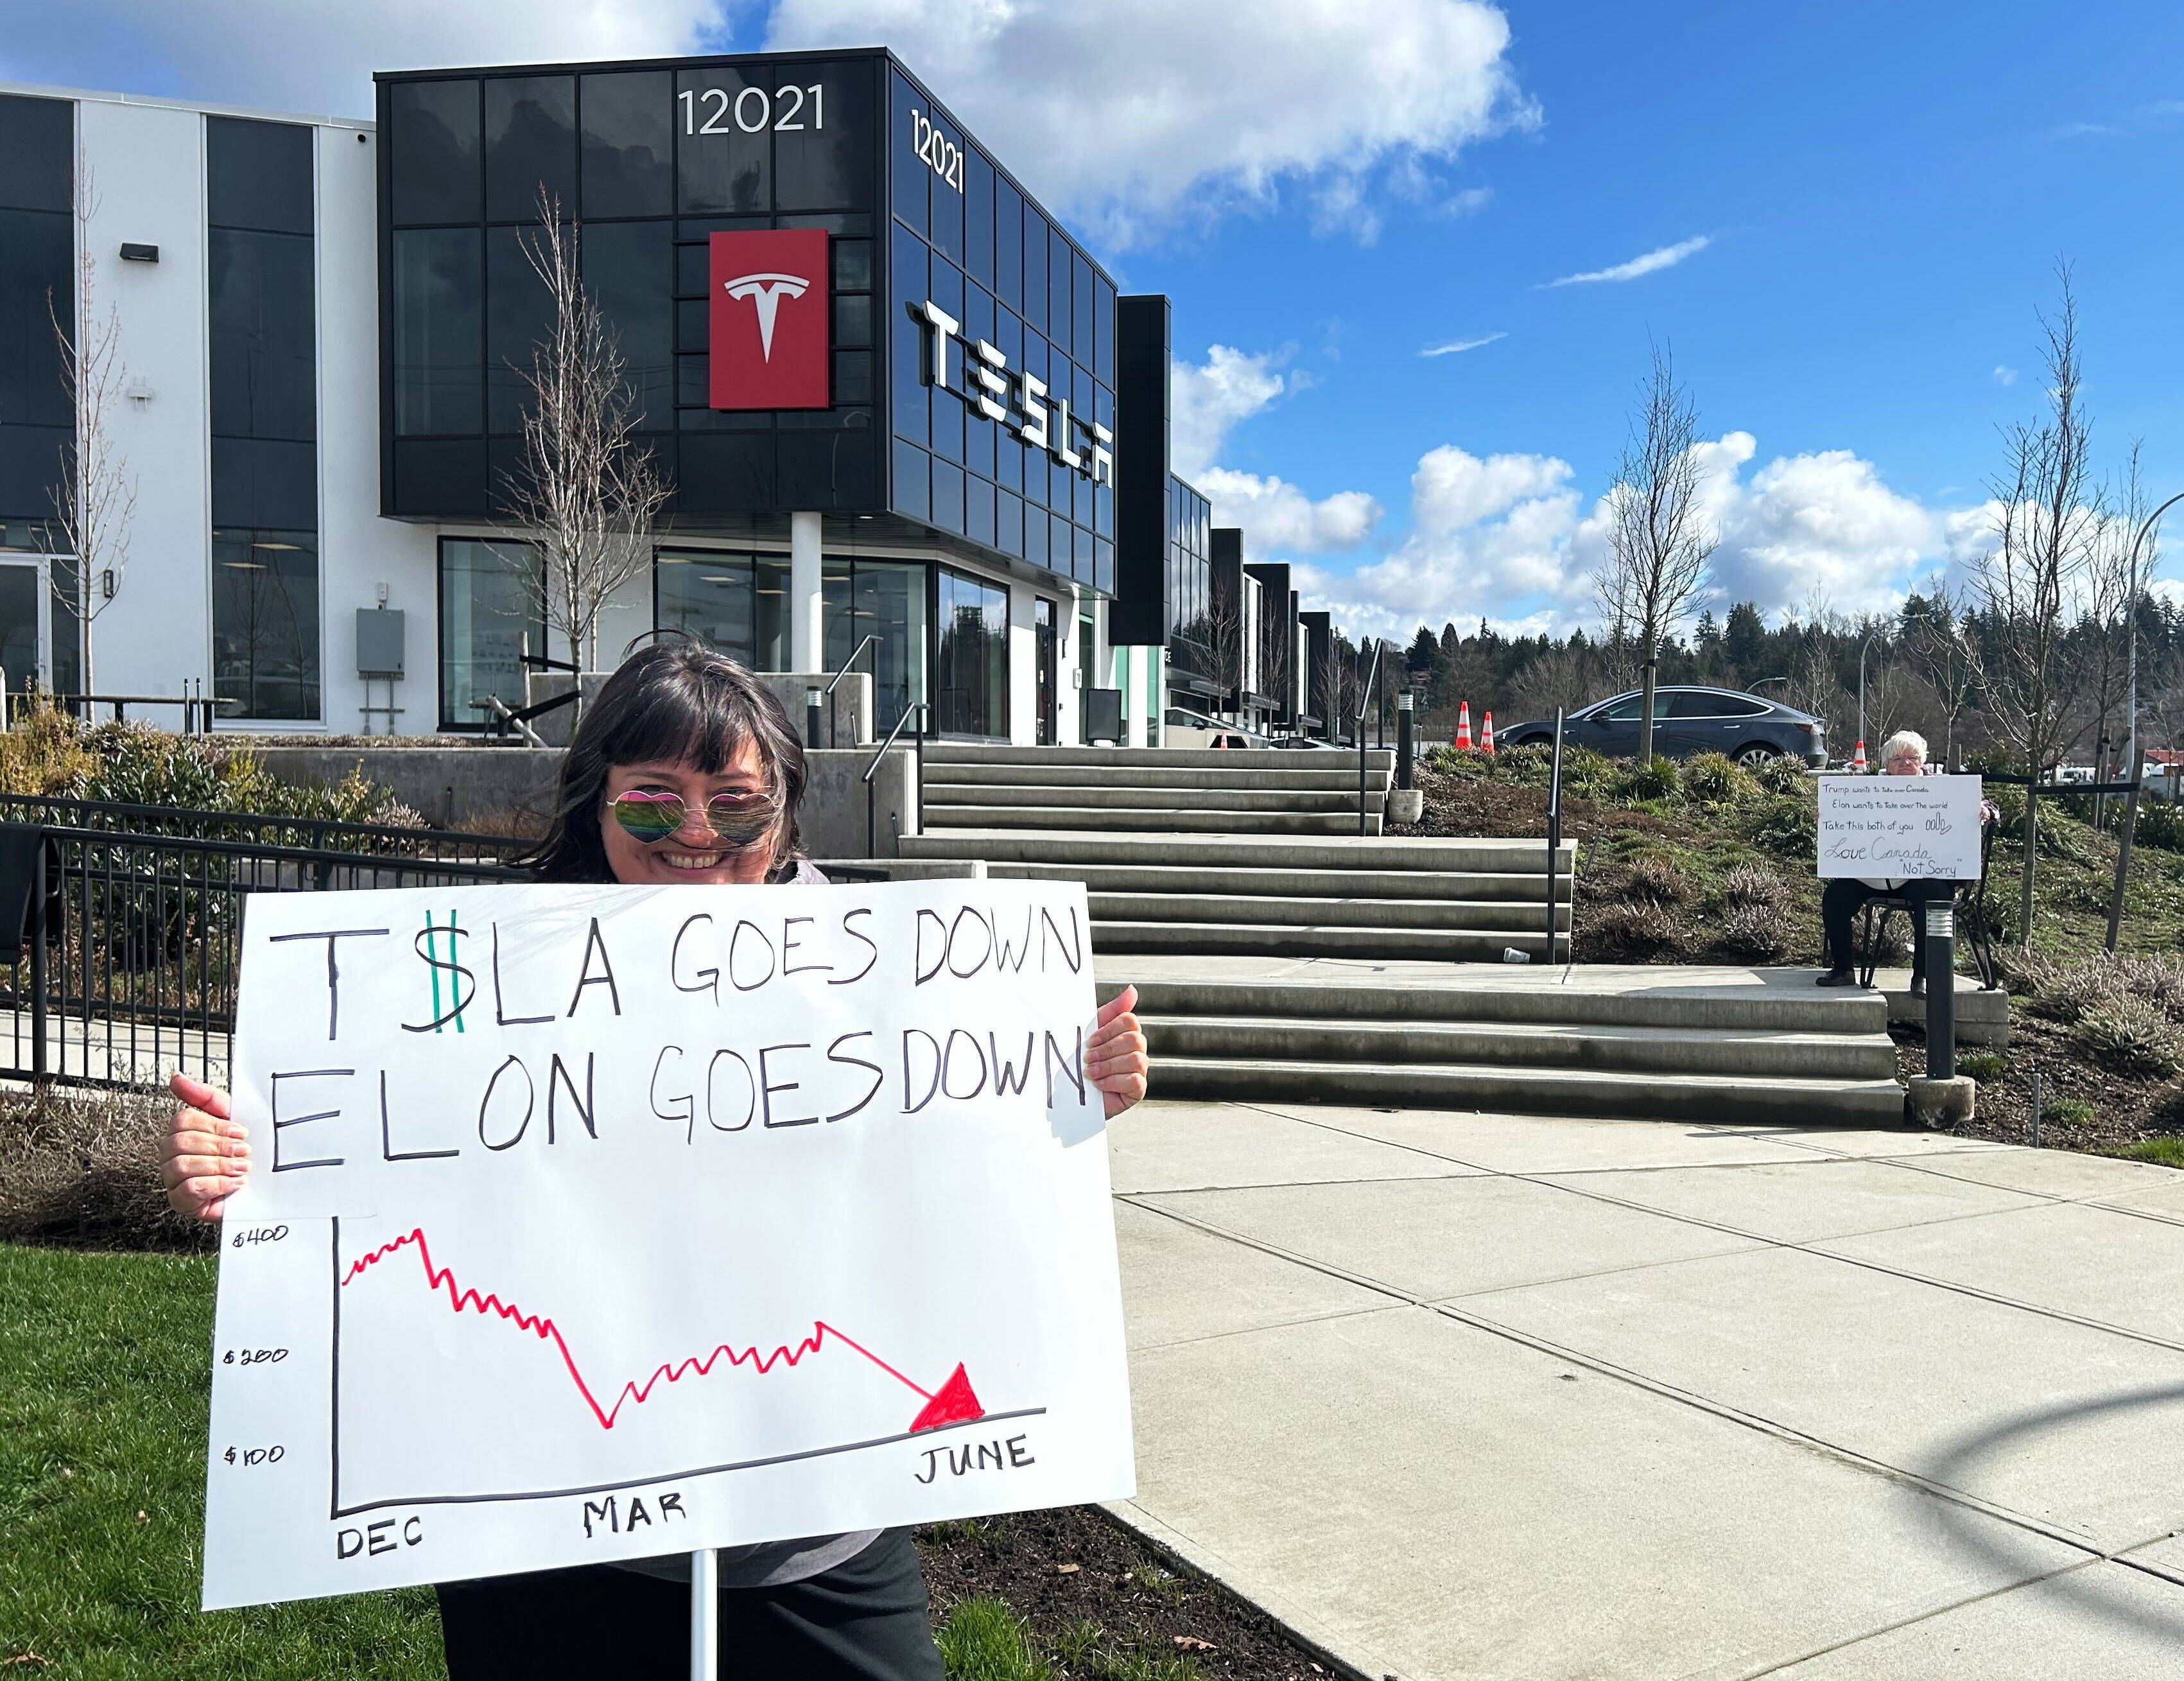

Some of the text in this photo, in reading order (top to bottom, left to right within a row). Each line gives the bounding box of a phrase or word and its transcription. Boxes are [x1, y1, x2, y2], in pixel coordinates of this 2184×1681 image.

[678, 83, 823, 135] 12021
[910, 109, 964, 194] 12021
[922, 300, 1113, 489] TESLA
[1822, 783, 1850, 796] Trump
[1906, 784, 1930, 793] Canada
[1832, 799, 1850, 809] Elon
[1876, 801, 1883, 809] to
[1823, 820, 1914, 835] Take this both of you
[1824, 836, 1932, 860] Love Canada
[671, 908, 878, 1007] GOES
[914, 905, 1082, 988] DOWN
[270, 1027, 1086, 1173] ELON GOES DOWN
[232, 1224, 289, 1248] $400
[336, 1433, 1036, 1560] DEC MAR JUNE
